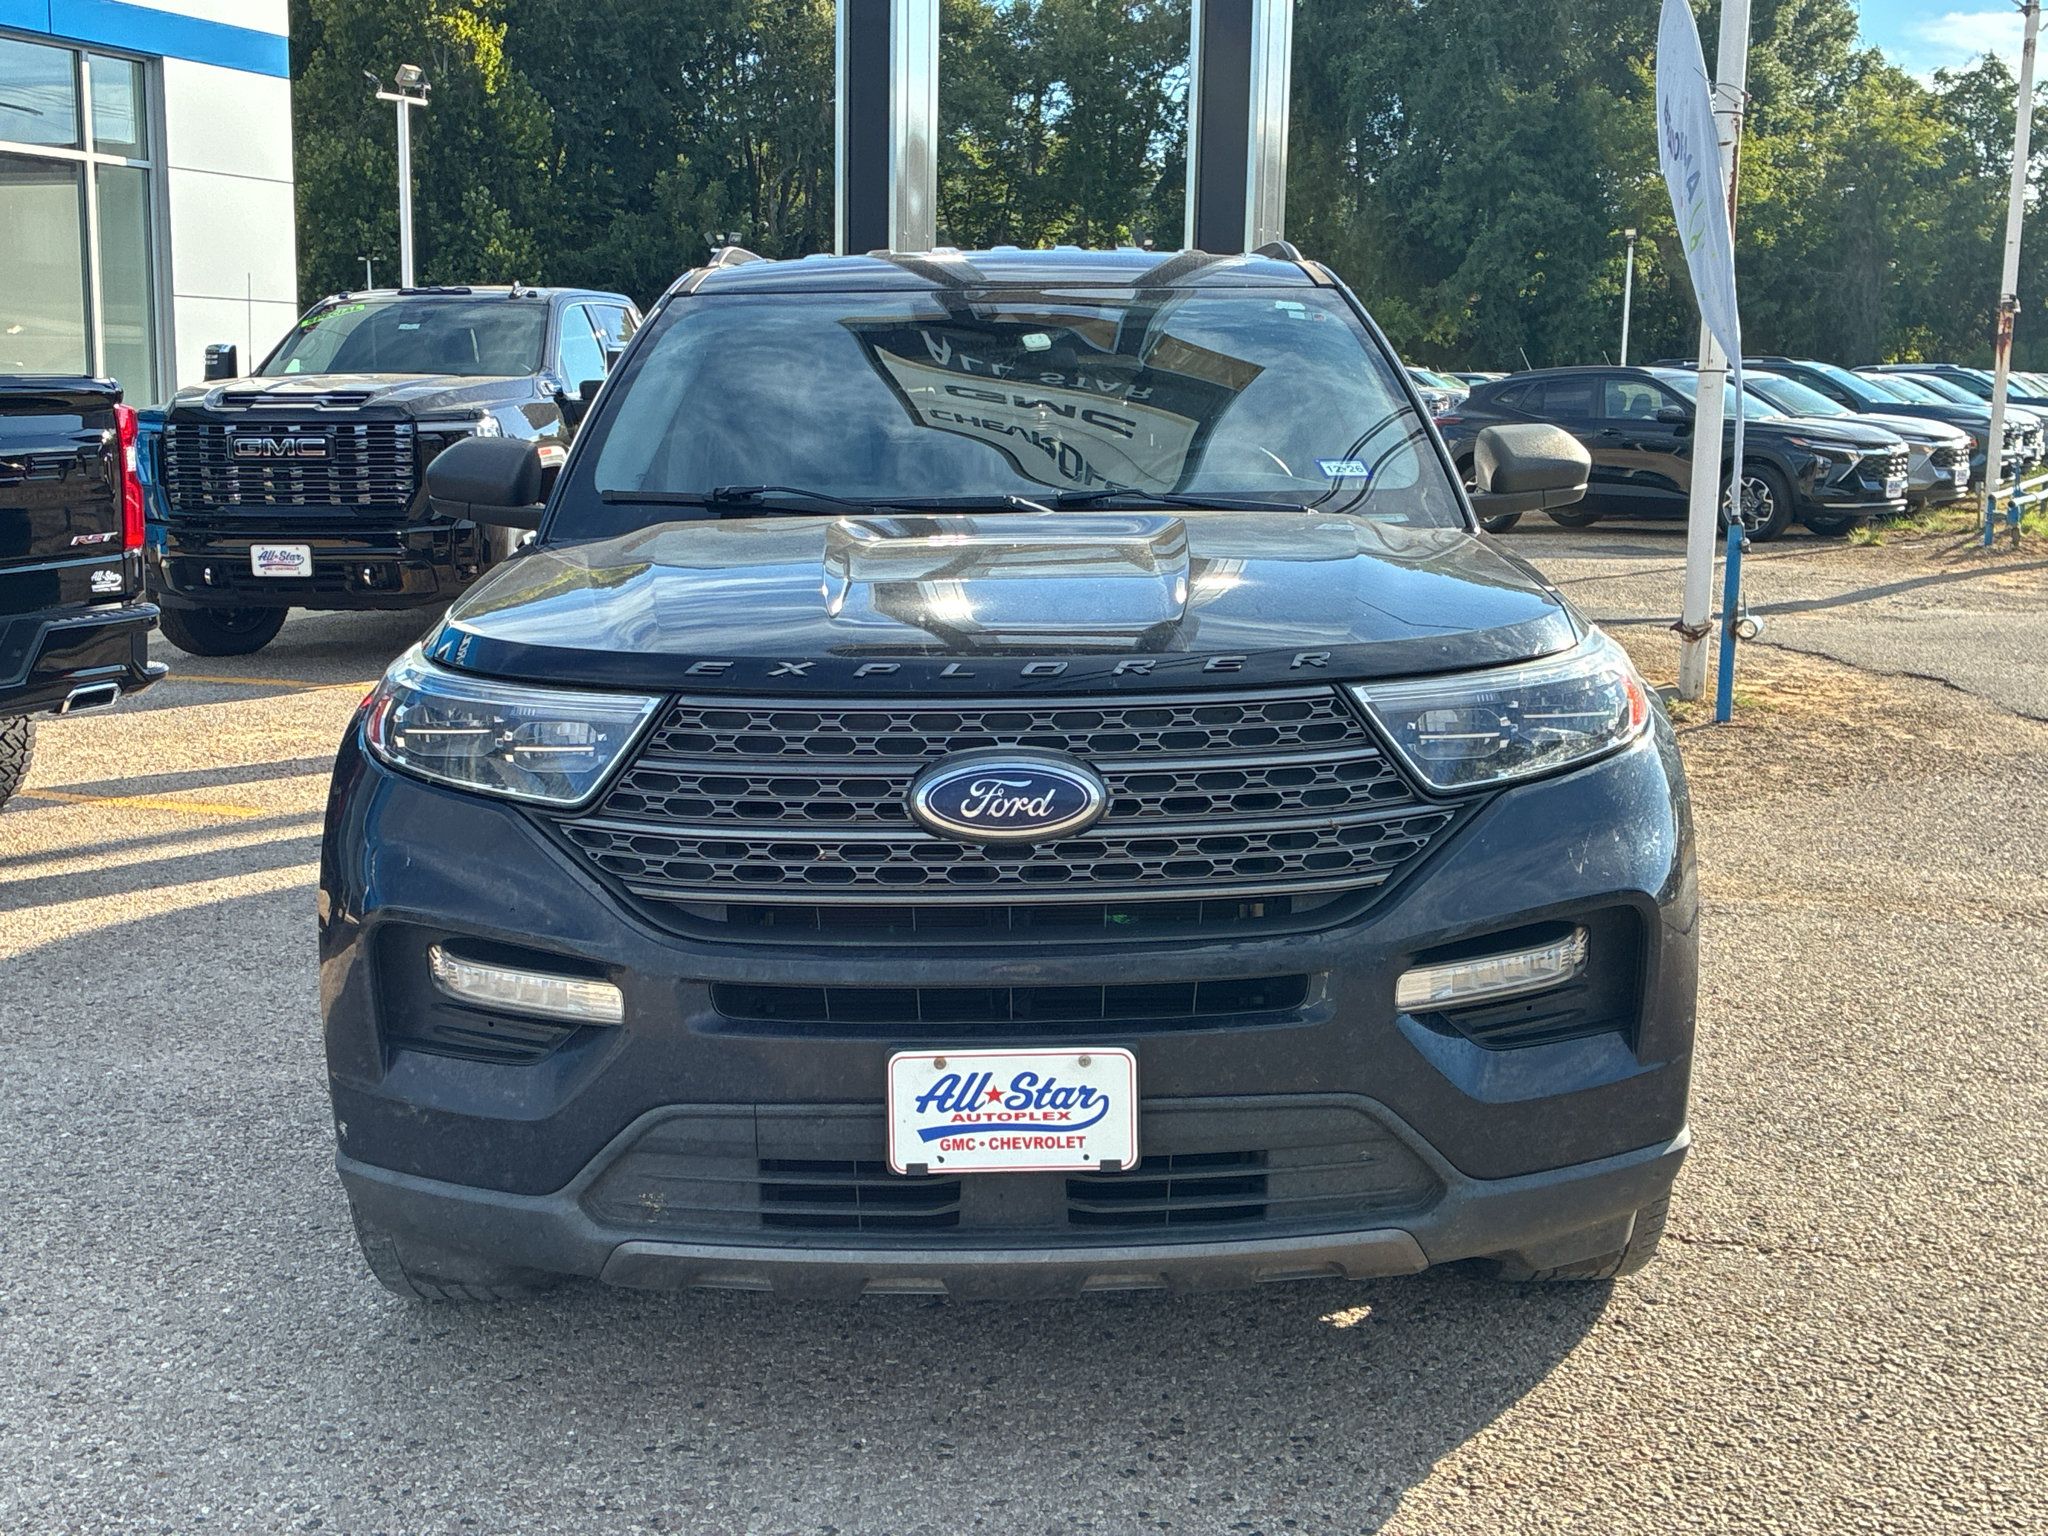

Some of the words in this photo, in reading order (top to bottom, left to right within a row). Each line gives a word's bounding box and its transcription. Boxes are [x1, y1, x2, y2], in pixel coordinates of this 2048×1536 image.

[233, 438, 326, 456] GMC
[684, 651, 1332, 679] EXPLORER
[960, 778, 1057, 819] Ford
[915, 1071, 994, 1114] All
[1004, 1071, 1099, 1111] Star
[950, 1111, 1072, 1123] AUTOPLEX
[939, 1137, 977, 1152] GMC
[988, 1135, 1087, 1150] CHEVROLET
